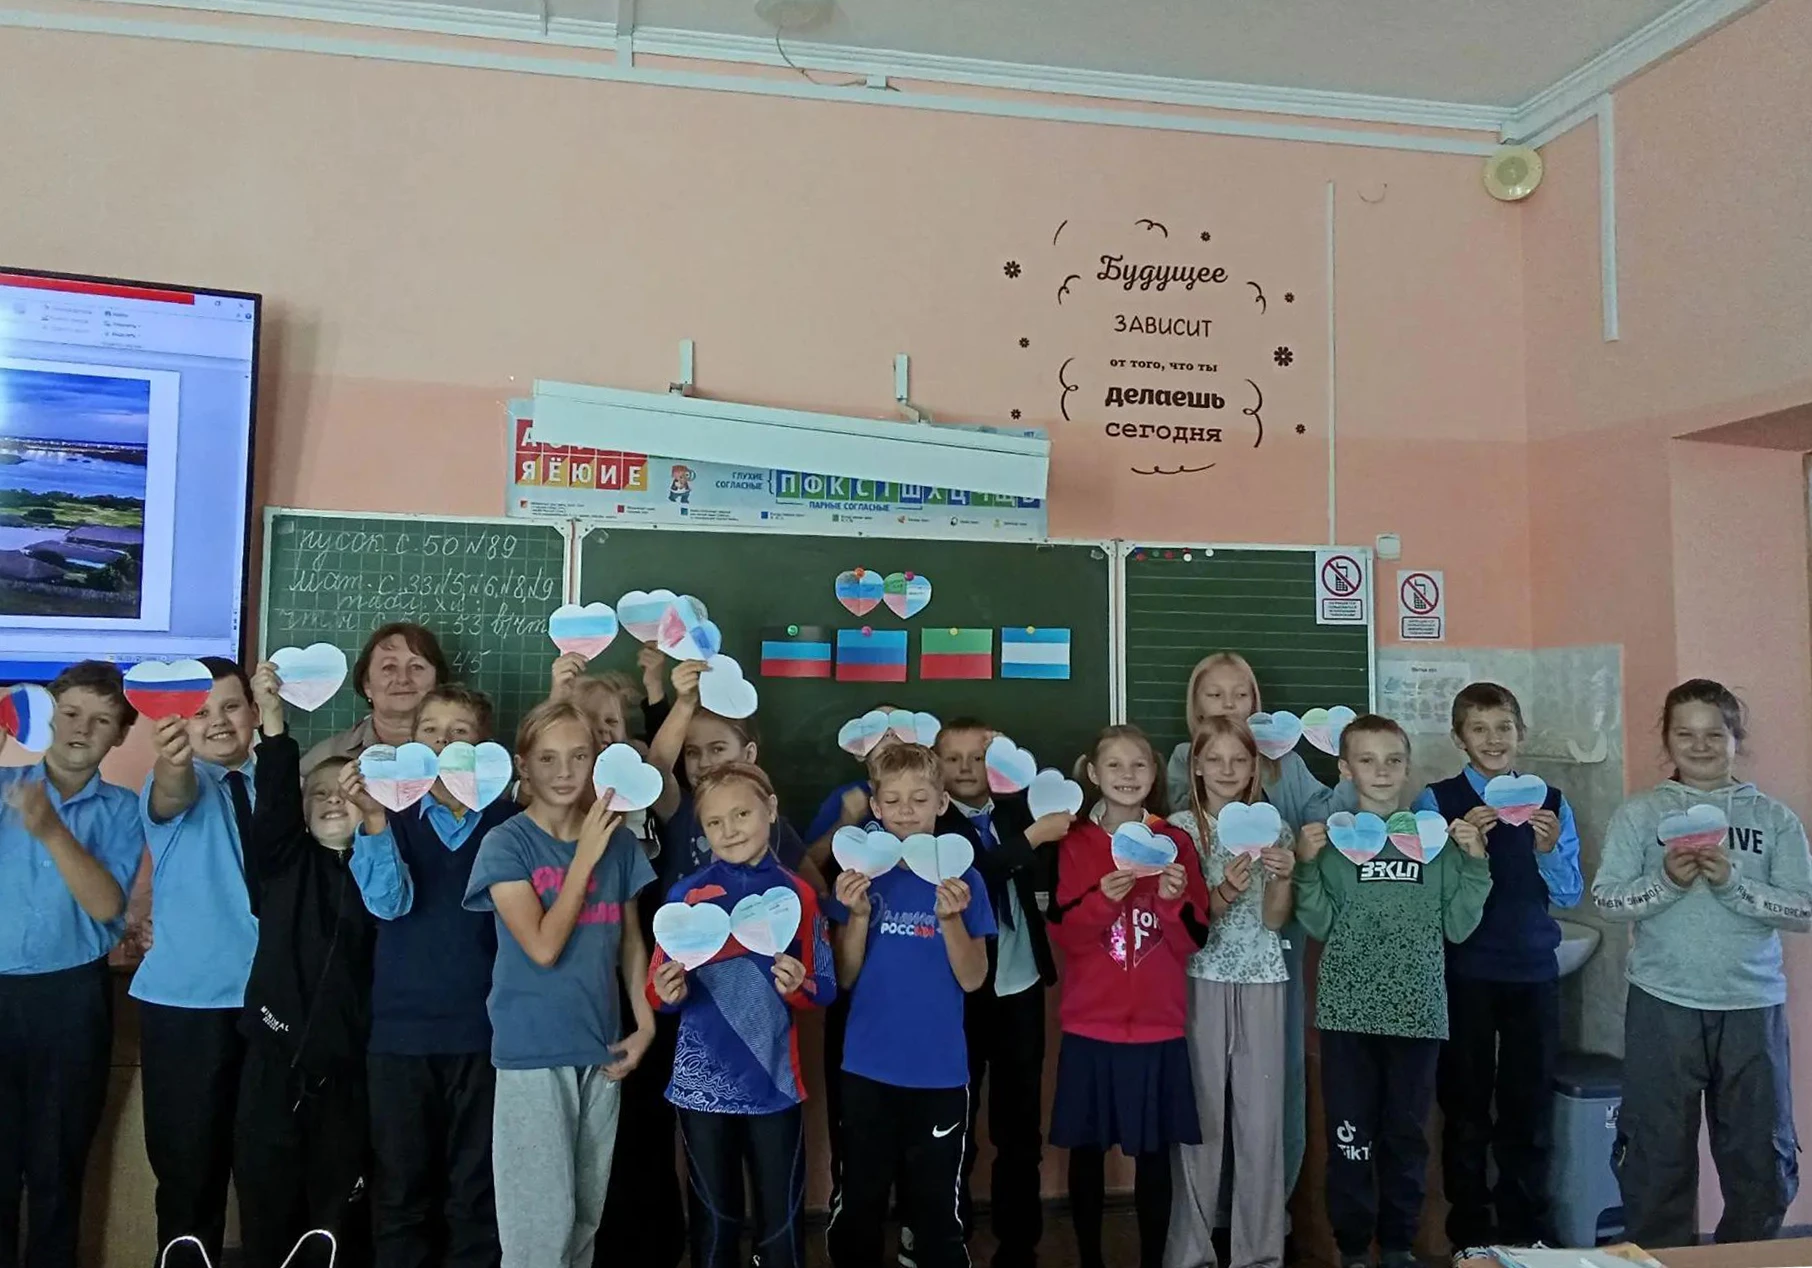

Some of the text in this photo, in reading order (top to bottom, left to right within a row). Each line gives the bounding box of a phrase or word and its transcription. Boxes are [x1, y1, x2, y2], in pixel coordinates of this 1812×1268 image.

[1097, 255, 1228, 291] Будущее
[1110, 359, 1217, 372] от того, что ты
[1105, 387, 1225, 409] делаешь
[1105, 421, 1222, 443] сегодня
[423, 535, 459, 556] 50
